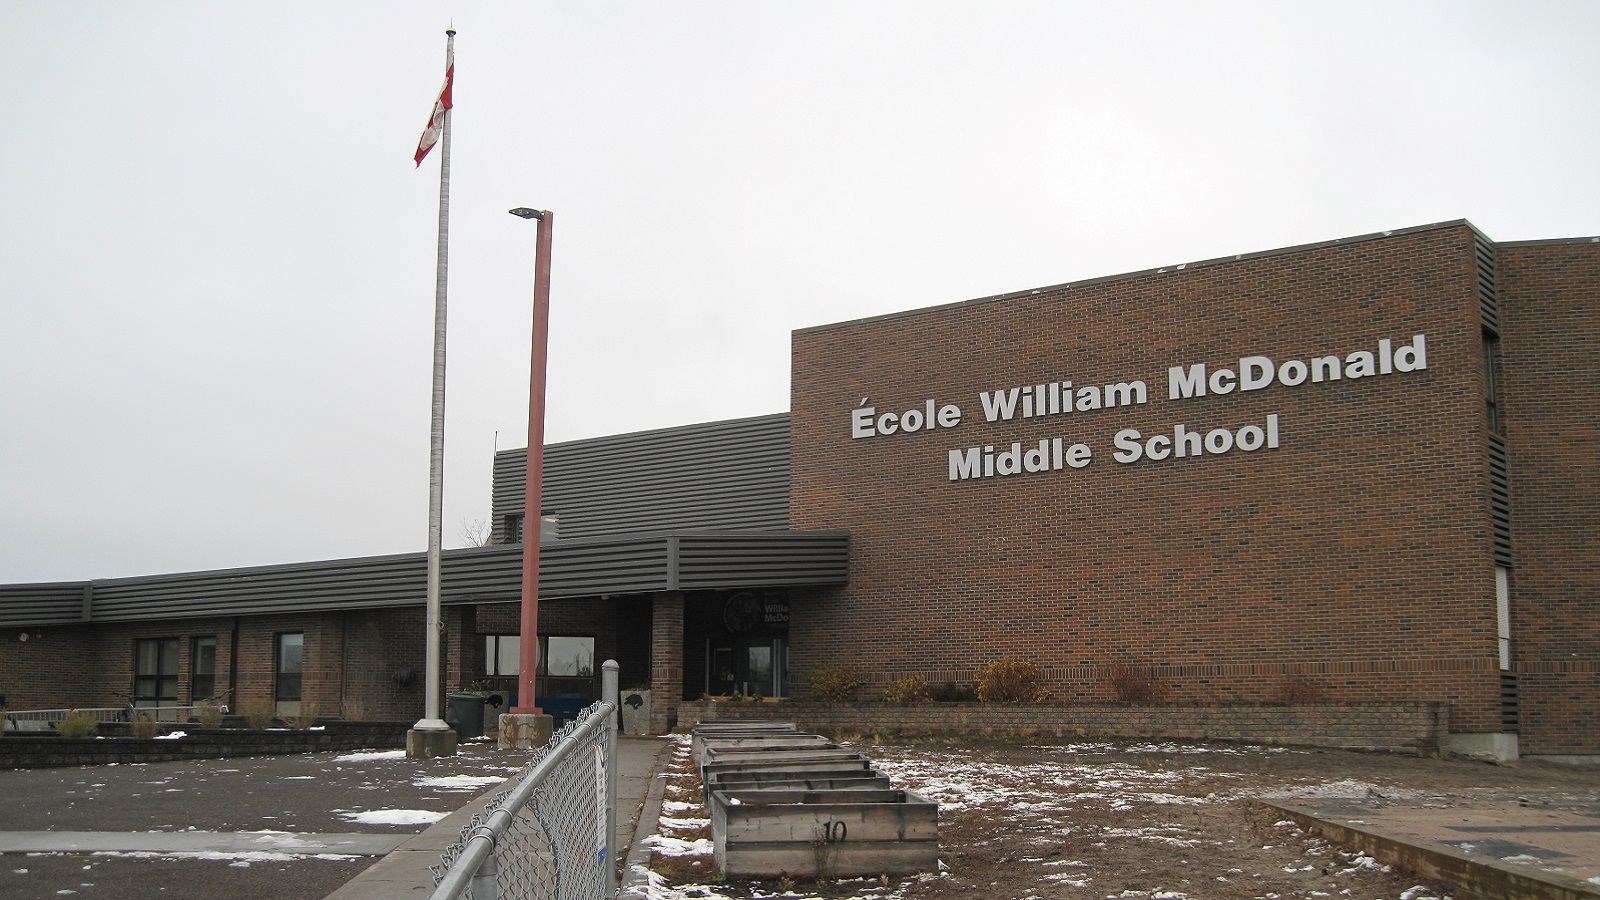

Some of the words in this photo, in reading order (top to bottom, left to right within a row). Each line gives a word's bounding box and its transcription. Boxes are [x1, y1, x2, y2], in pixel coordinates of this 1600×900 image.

[851, 397, 962, 439] École
[979, 380, 1147, 422] William
[1168, 334, 1427, 400] McDonald
[948, 437, 1092, 482] Middle
[1112, 414, 1280, 463] School
[822, 820, 848, 844] 10
